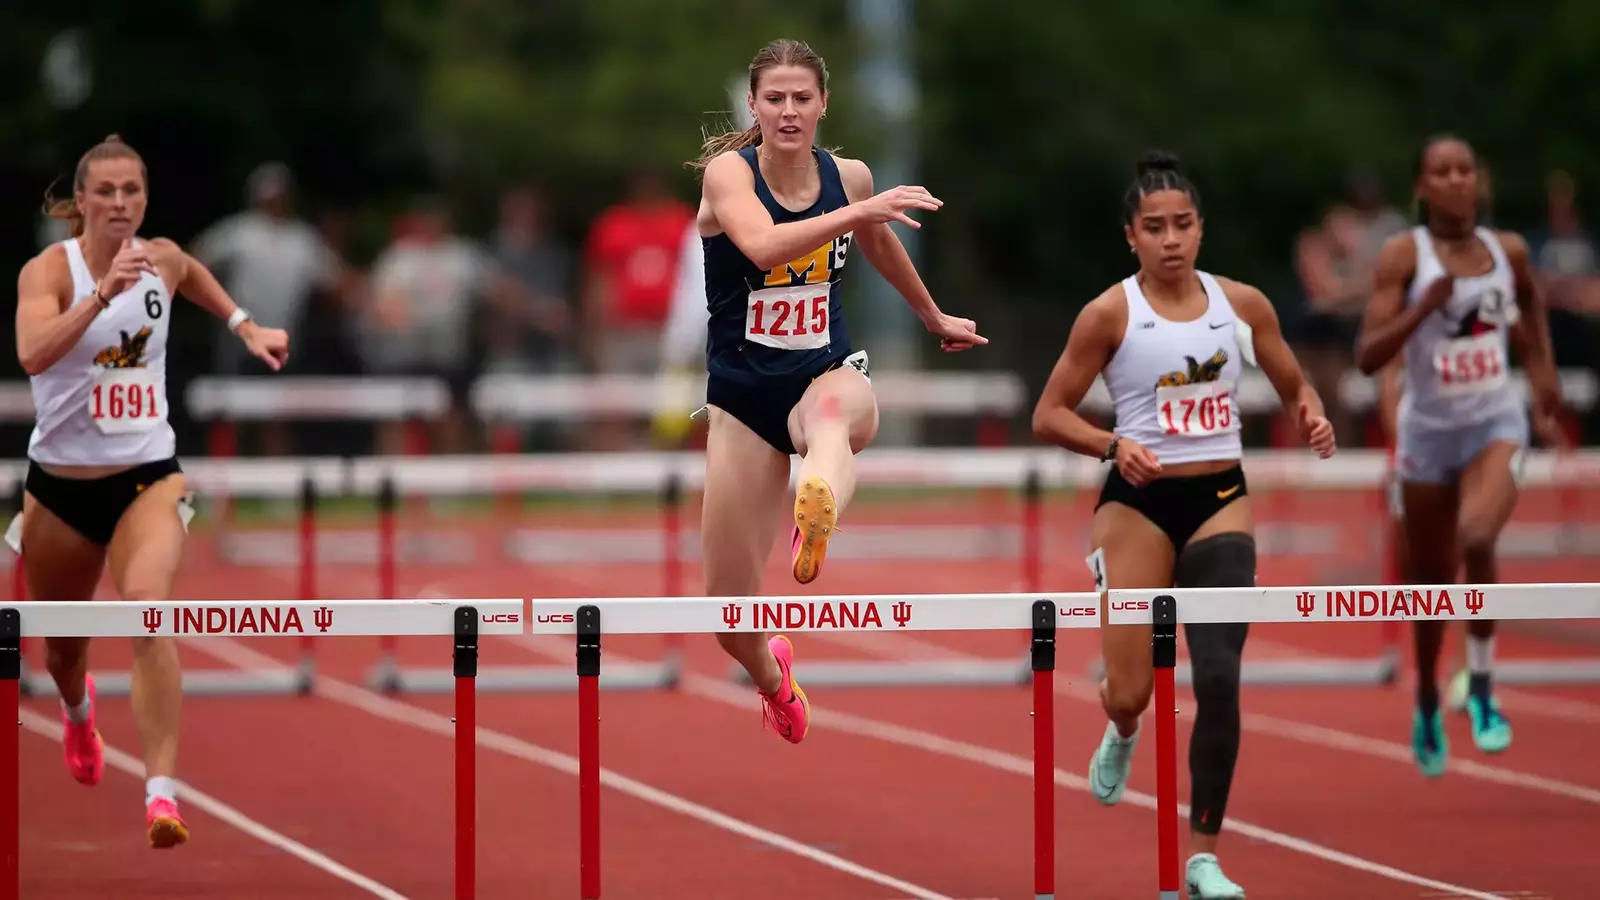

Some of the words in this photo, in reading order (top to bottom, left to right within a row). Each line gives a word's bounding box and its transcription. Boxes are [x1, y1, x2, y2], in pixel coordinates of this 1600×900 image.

[837, 234, 850, 261] 5
[144, 290, 163, 319] 6
[749, 296, 828, 336] 1215
[92, 384, 160, 419] 1691
[1161, 392, 1231, 435] 1705
[752, 602, 882, 629] INDIANA
[1060, 607, 1096, 616] UCS
[1111, 601, 1149, 610] UCS
[1326, 590, 1455, 617] INDIANA
[173, 607, 304, 633] INDIANA
[482, 614, 519, 623] UCS
[537, 614, 574, 623] UCS
